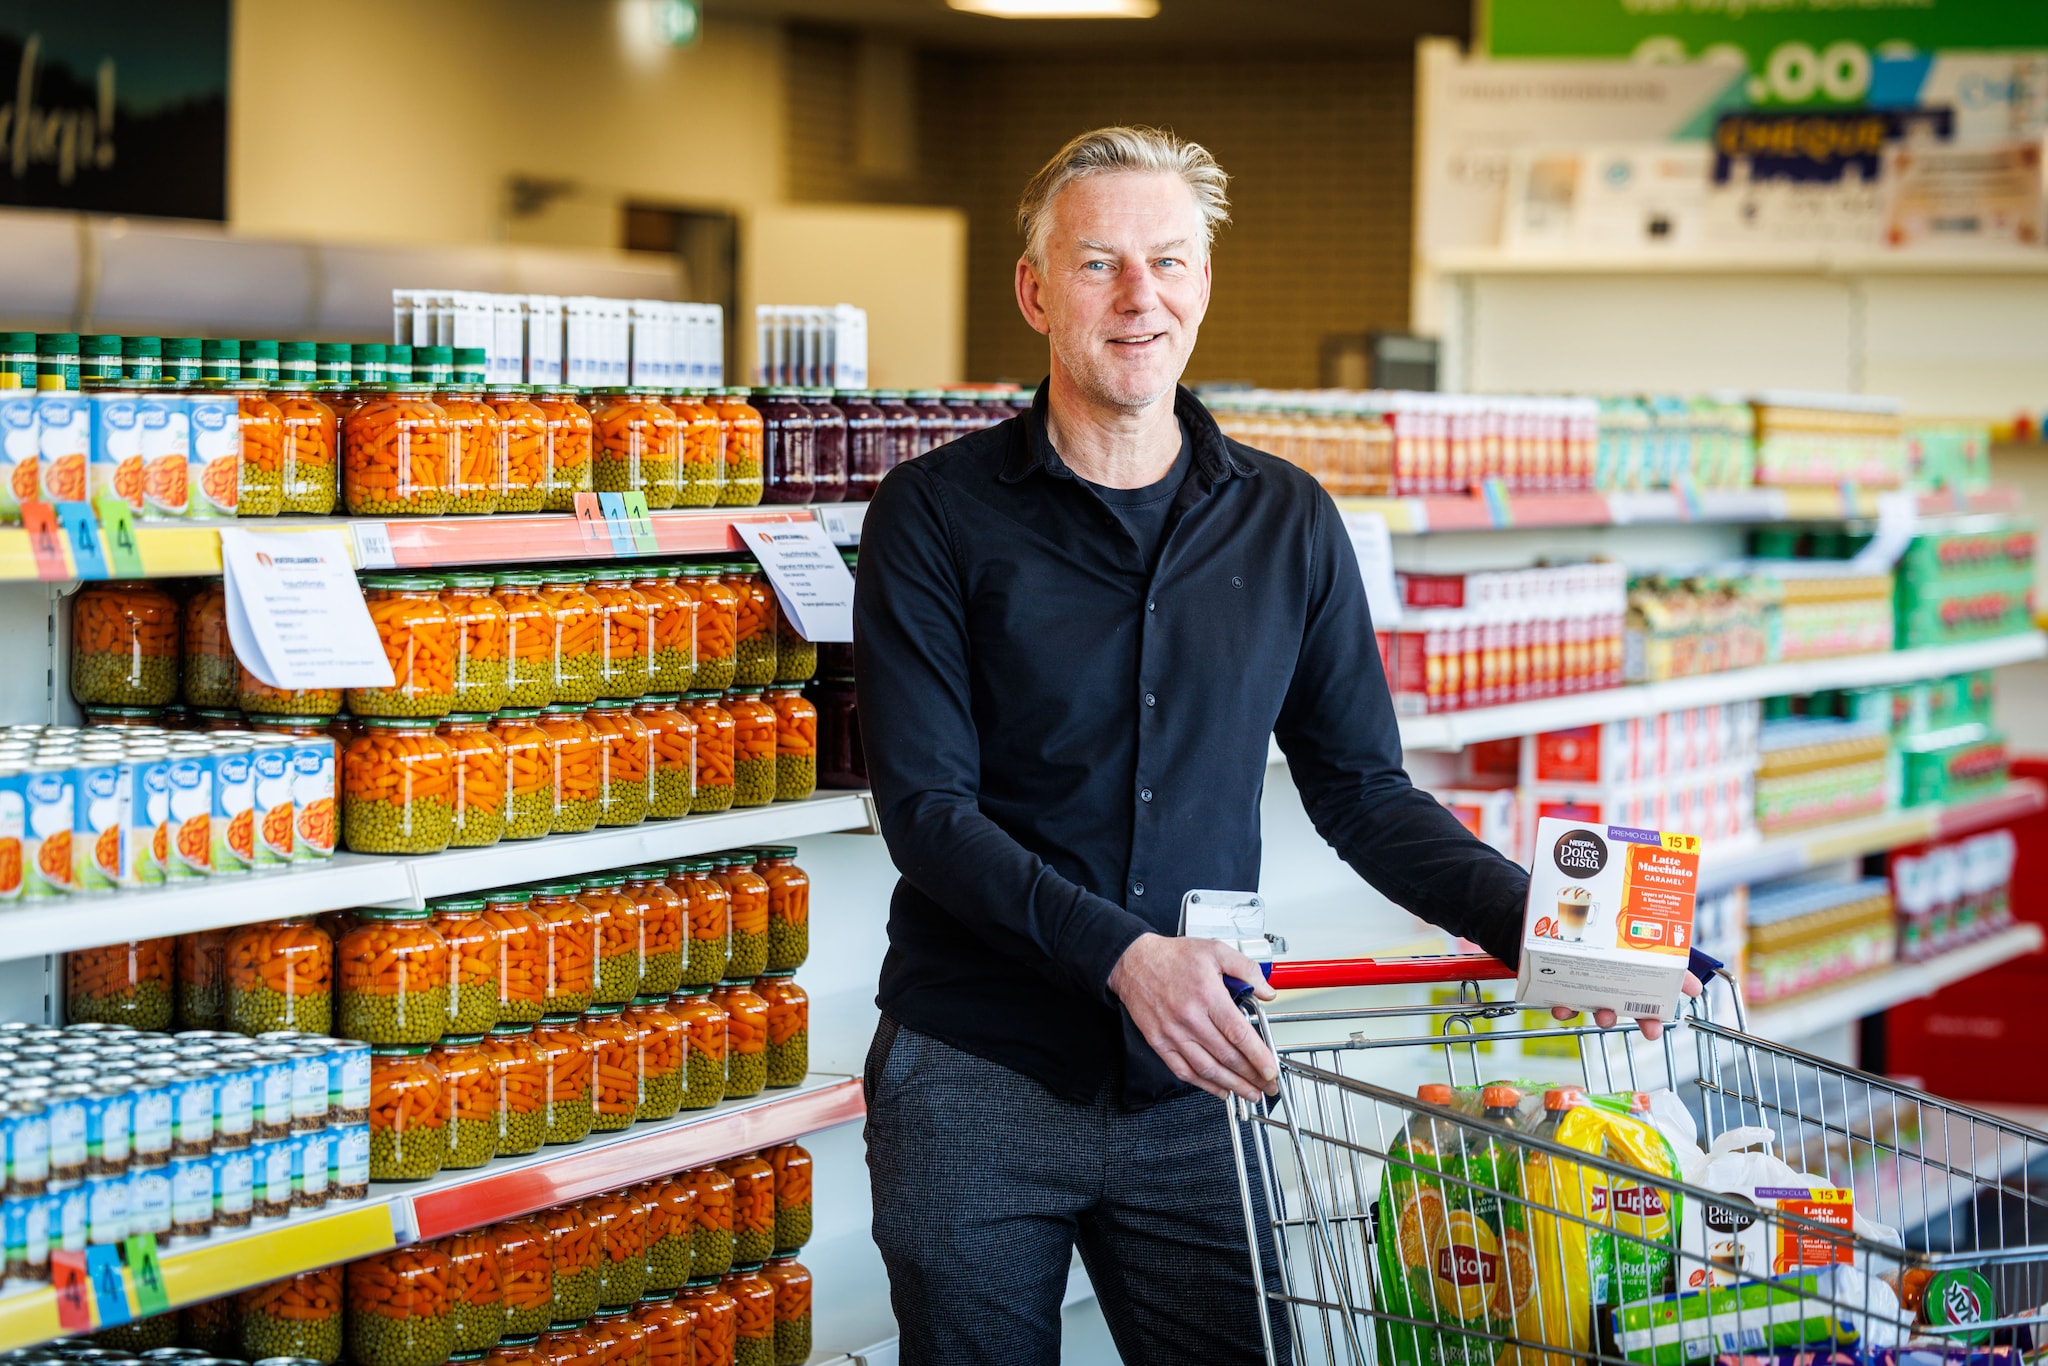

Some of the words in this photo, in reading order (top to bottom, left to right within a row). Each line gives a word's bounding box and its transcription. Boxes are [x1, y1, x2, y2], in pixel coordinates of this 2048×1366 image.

[1610, 828, 1639, 840] PREMIO
[1639, 831, 1660, 843] CLUB
[1668, 836, 1682, 848] 15
[1560, 844, 1600, 859] Dolce
[1560, 856, 1599, 870] Gusto
[1652, 854, 1681, 866] Latte
[1637, 861, 1693, 878] Macchiato
[1641, 890, 1657, 898] Layers
[1758, 1188, 1788, 1197] PREMIO
[1788, 1189, 1809, 1197] CLUB
[1818, 1190, 1833, 1200] 15
[1803, 1206, 1834, 1216] Latte
